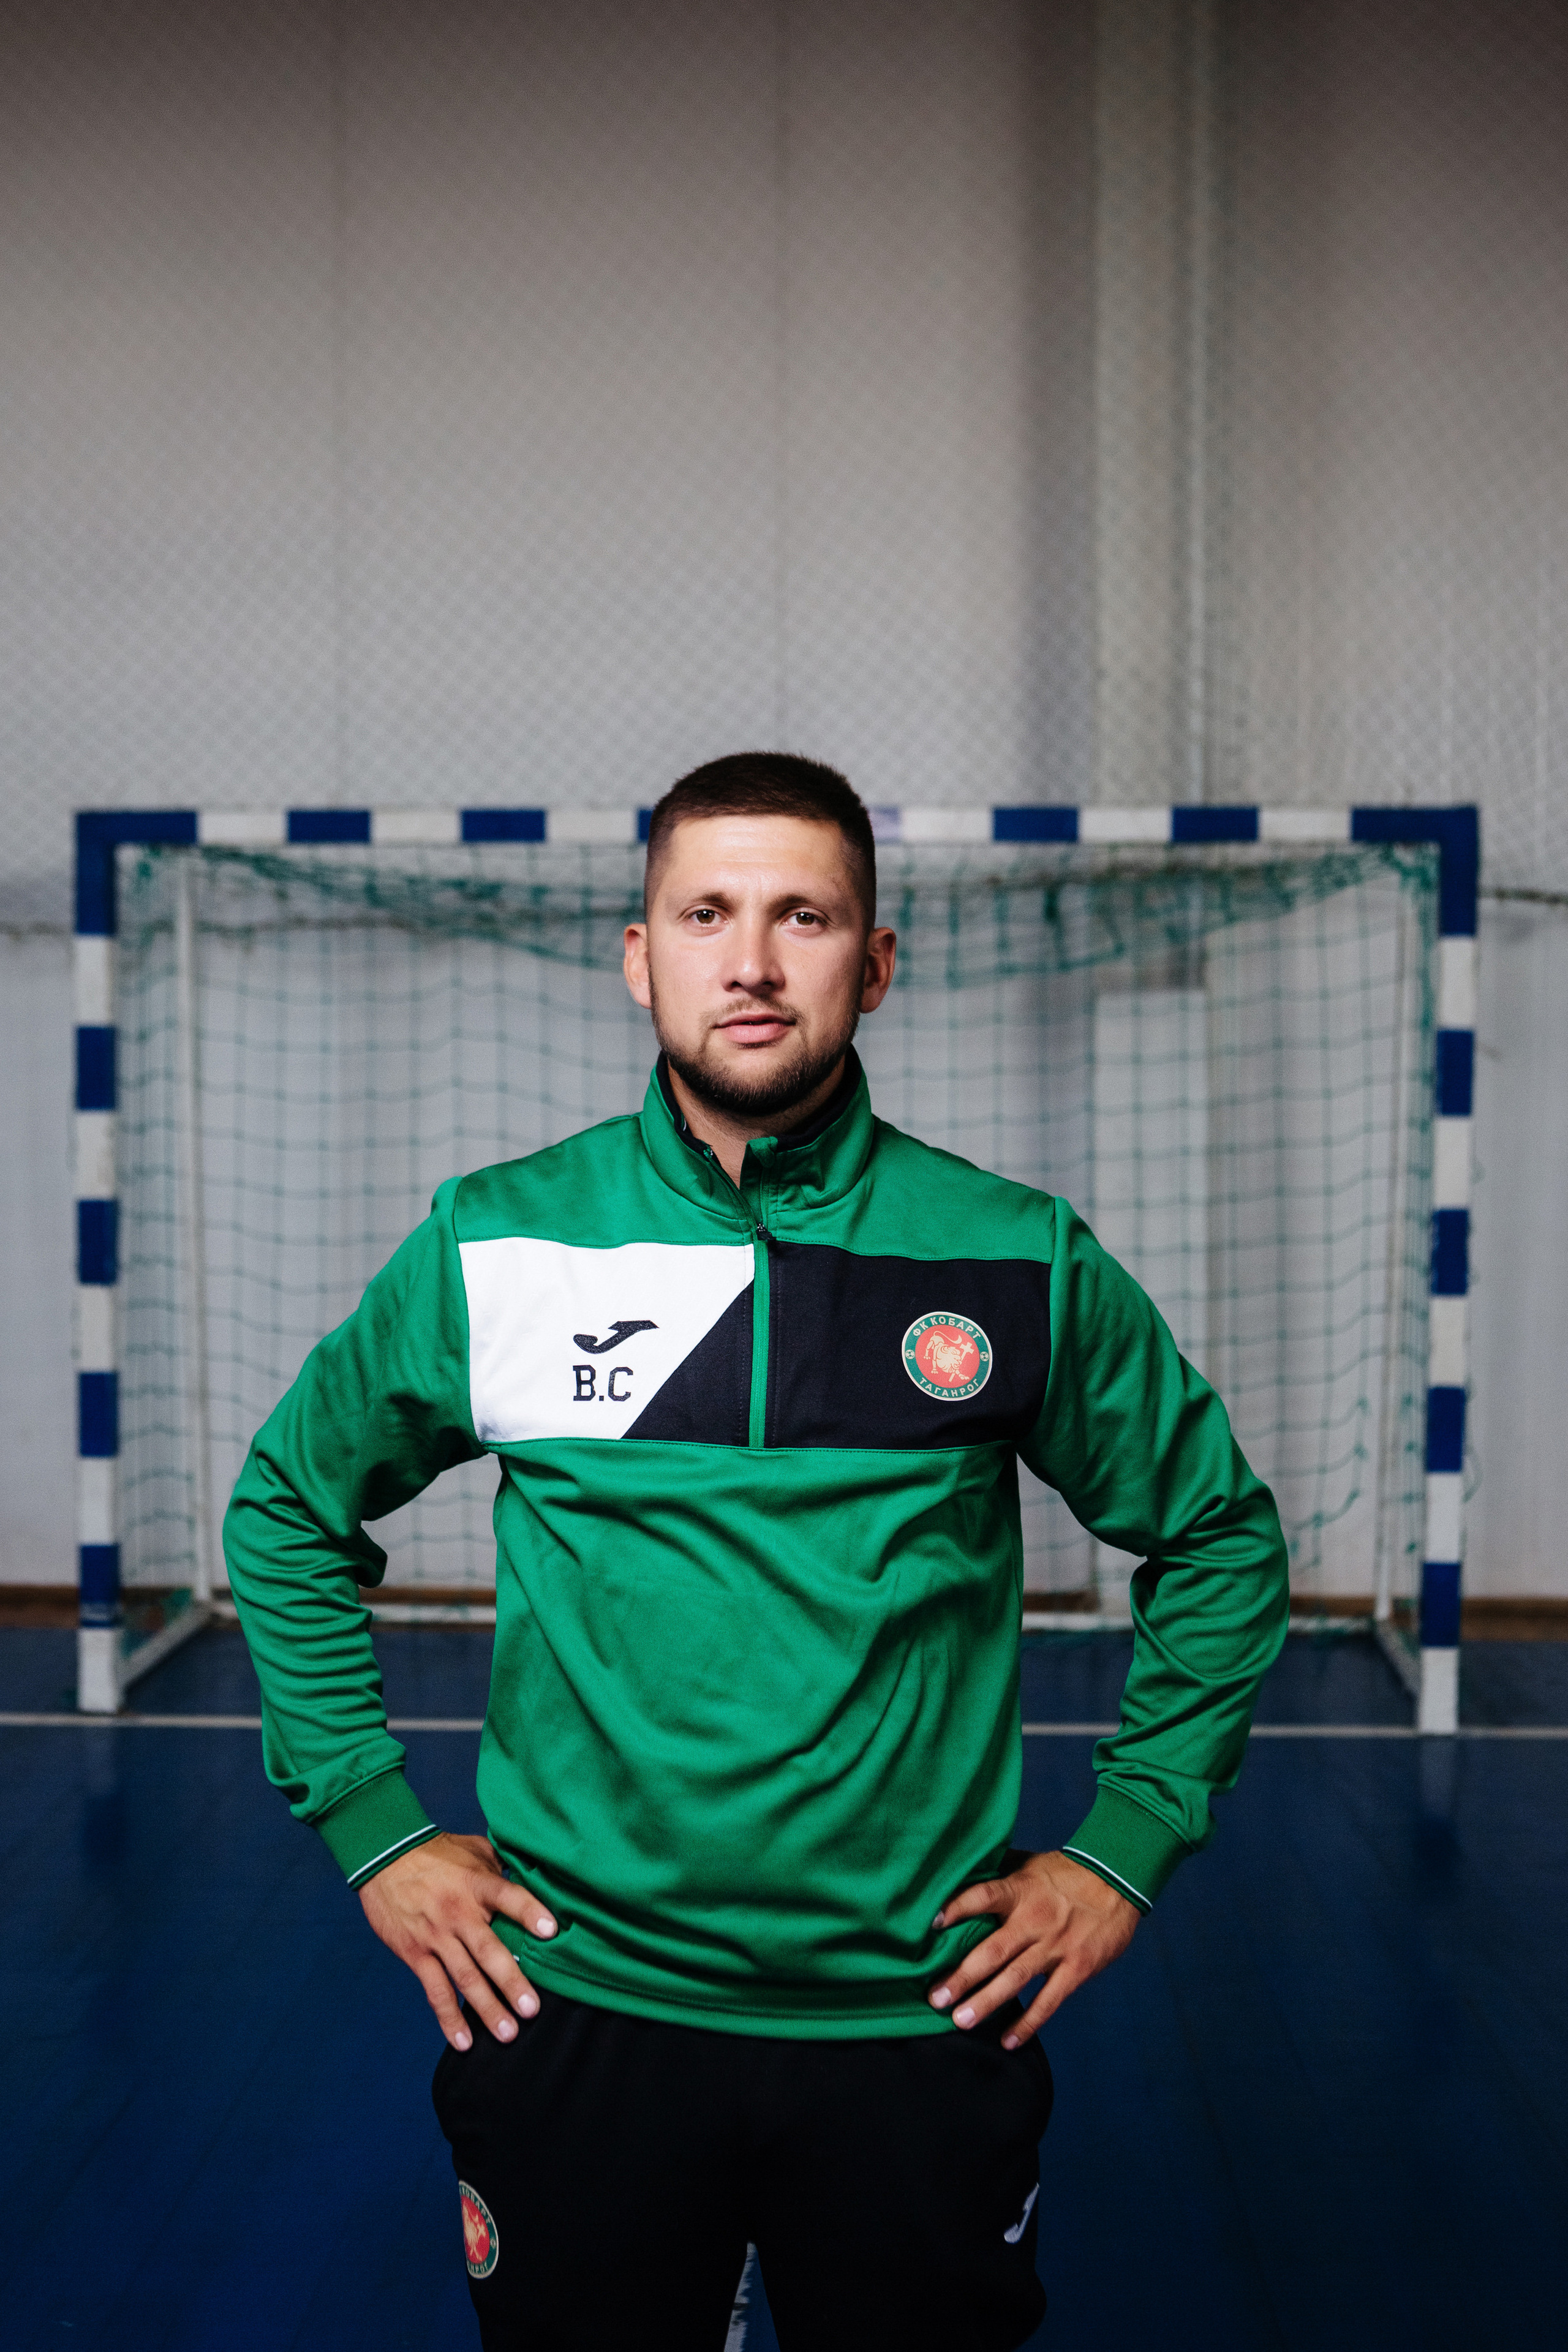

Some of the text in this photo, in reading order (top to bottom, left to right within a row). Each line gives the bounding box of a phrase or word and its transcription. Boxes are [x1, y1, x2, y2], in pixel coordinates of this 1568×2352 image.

[912, 1316, 981, 1340] ФК КОБАРТ
[919, 1377, 980, 1397] ТАГАНРОГ
